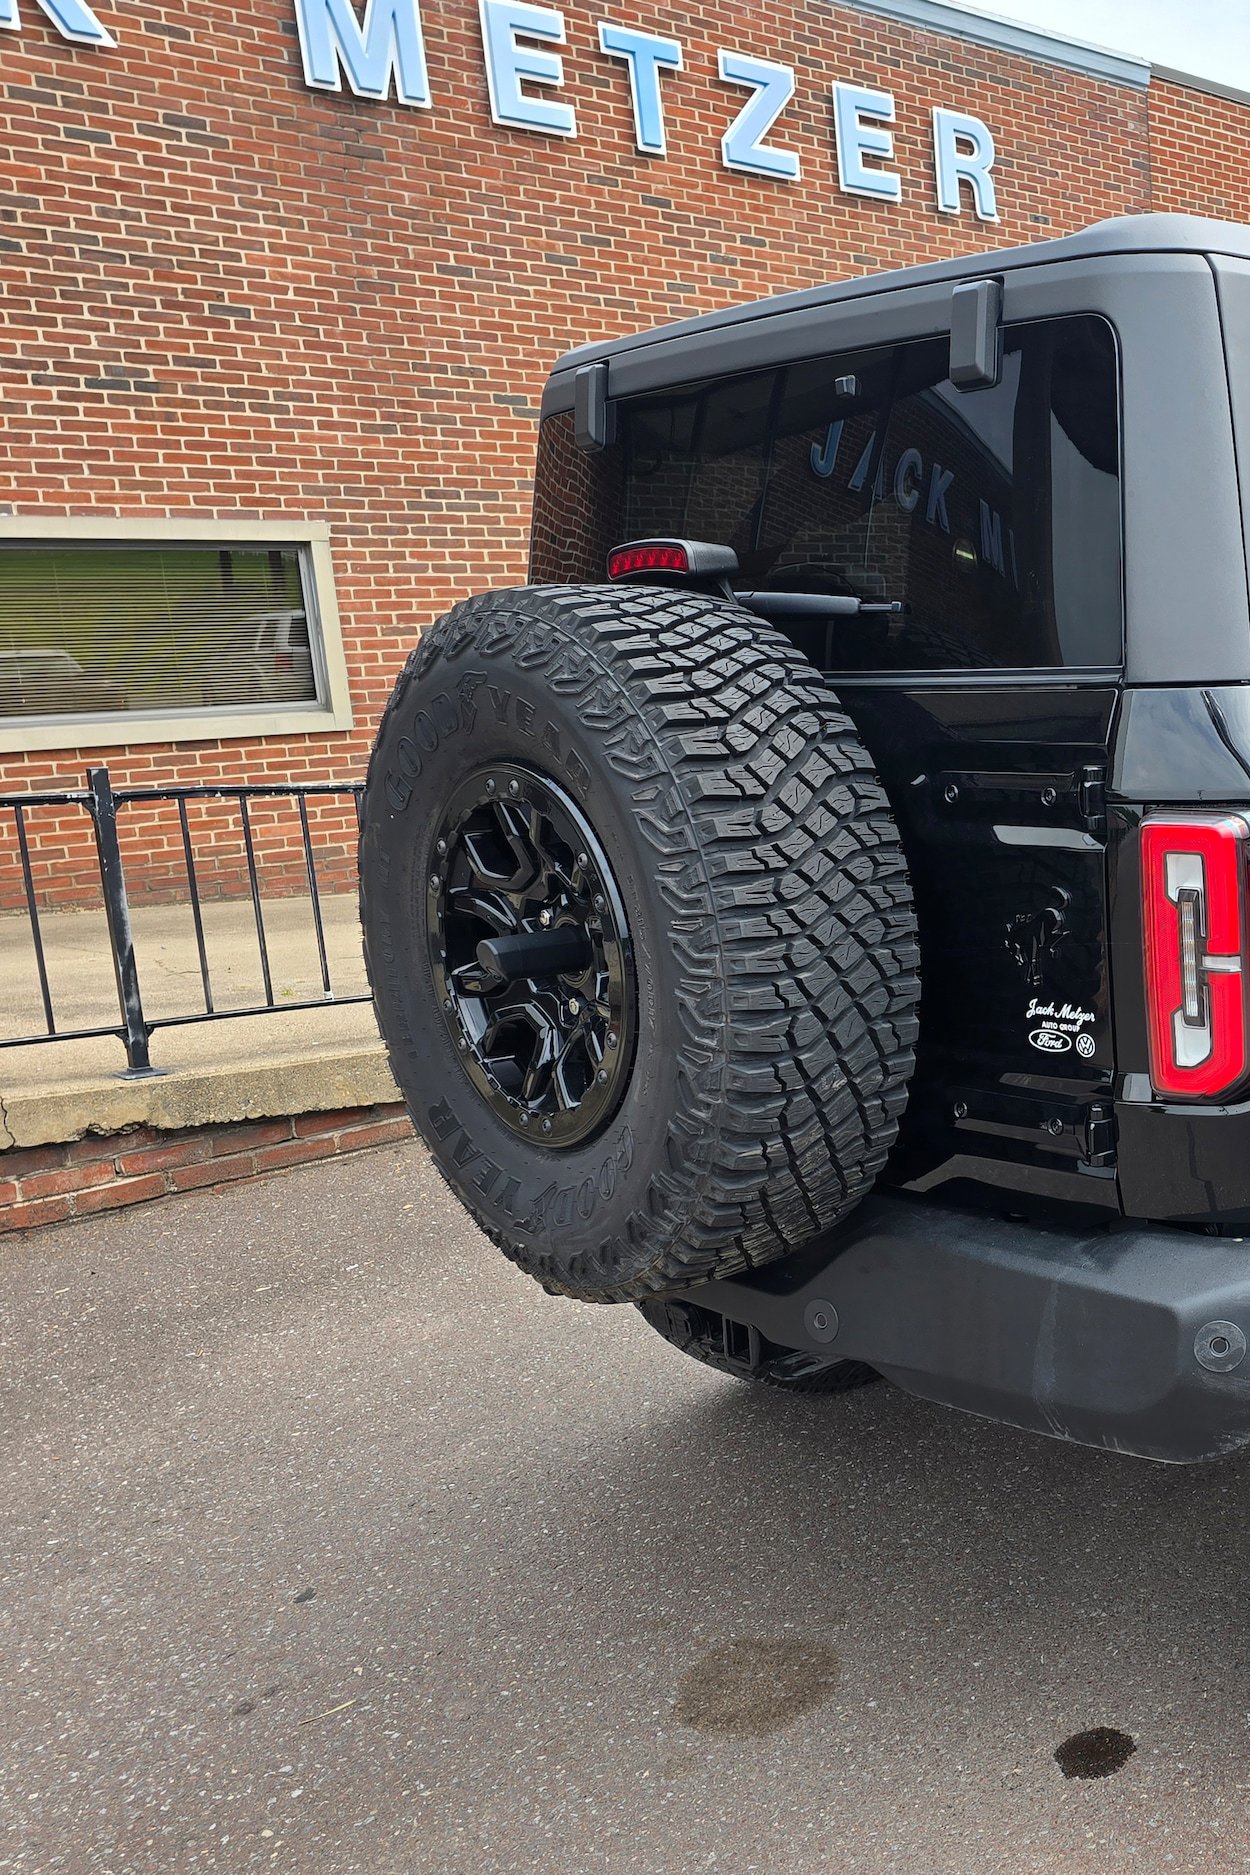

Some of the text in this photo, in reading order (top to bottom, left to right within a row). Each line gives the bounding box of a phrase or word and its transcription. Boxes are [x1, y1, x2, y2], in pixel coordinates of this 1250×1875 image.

[294, 0, 1001, 223] METZER
[1026, 998, 1096, 1026] Jack Metzer
[1041, 1021, 1081, 1033] AUTO GROUP
[1035, 1032, 1065, 1049] Ford
